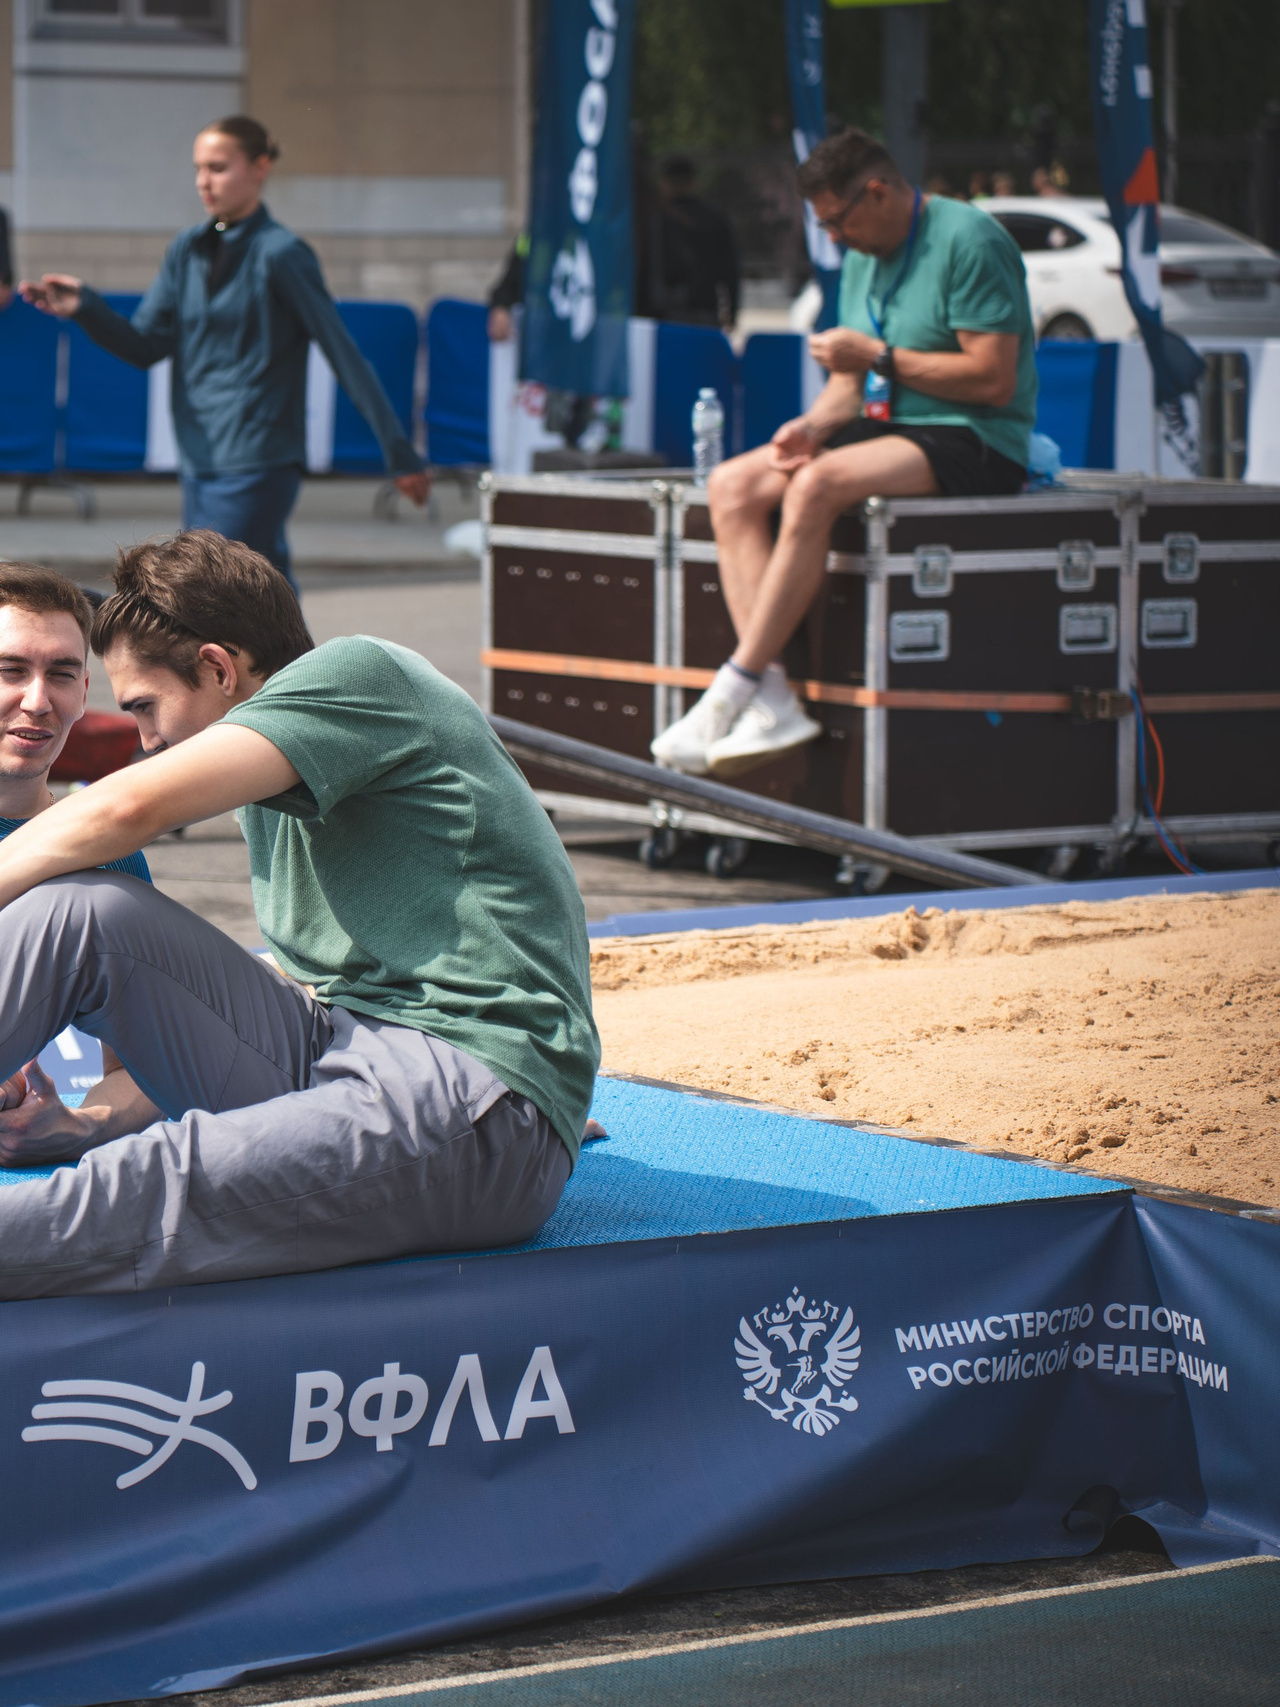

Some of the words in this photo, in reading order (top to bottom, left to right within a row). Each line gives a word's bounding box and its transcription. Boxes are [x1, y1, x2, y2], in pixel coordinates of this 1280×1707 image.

[894, 1303, 1094, 1354] МИНИСТЕРСТВО
[1103, 1303, 1207, 1346] СПОРТА
[906, 1340, 1070, 1391] РОССИЙСКОЙ
[1072, 1343, 1229, 1393] ФЕДЕРАЦИИ
[289, 1346, 576, 1463] ВФЛА
